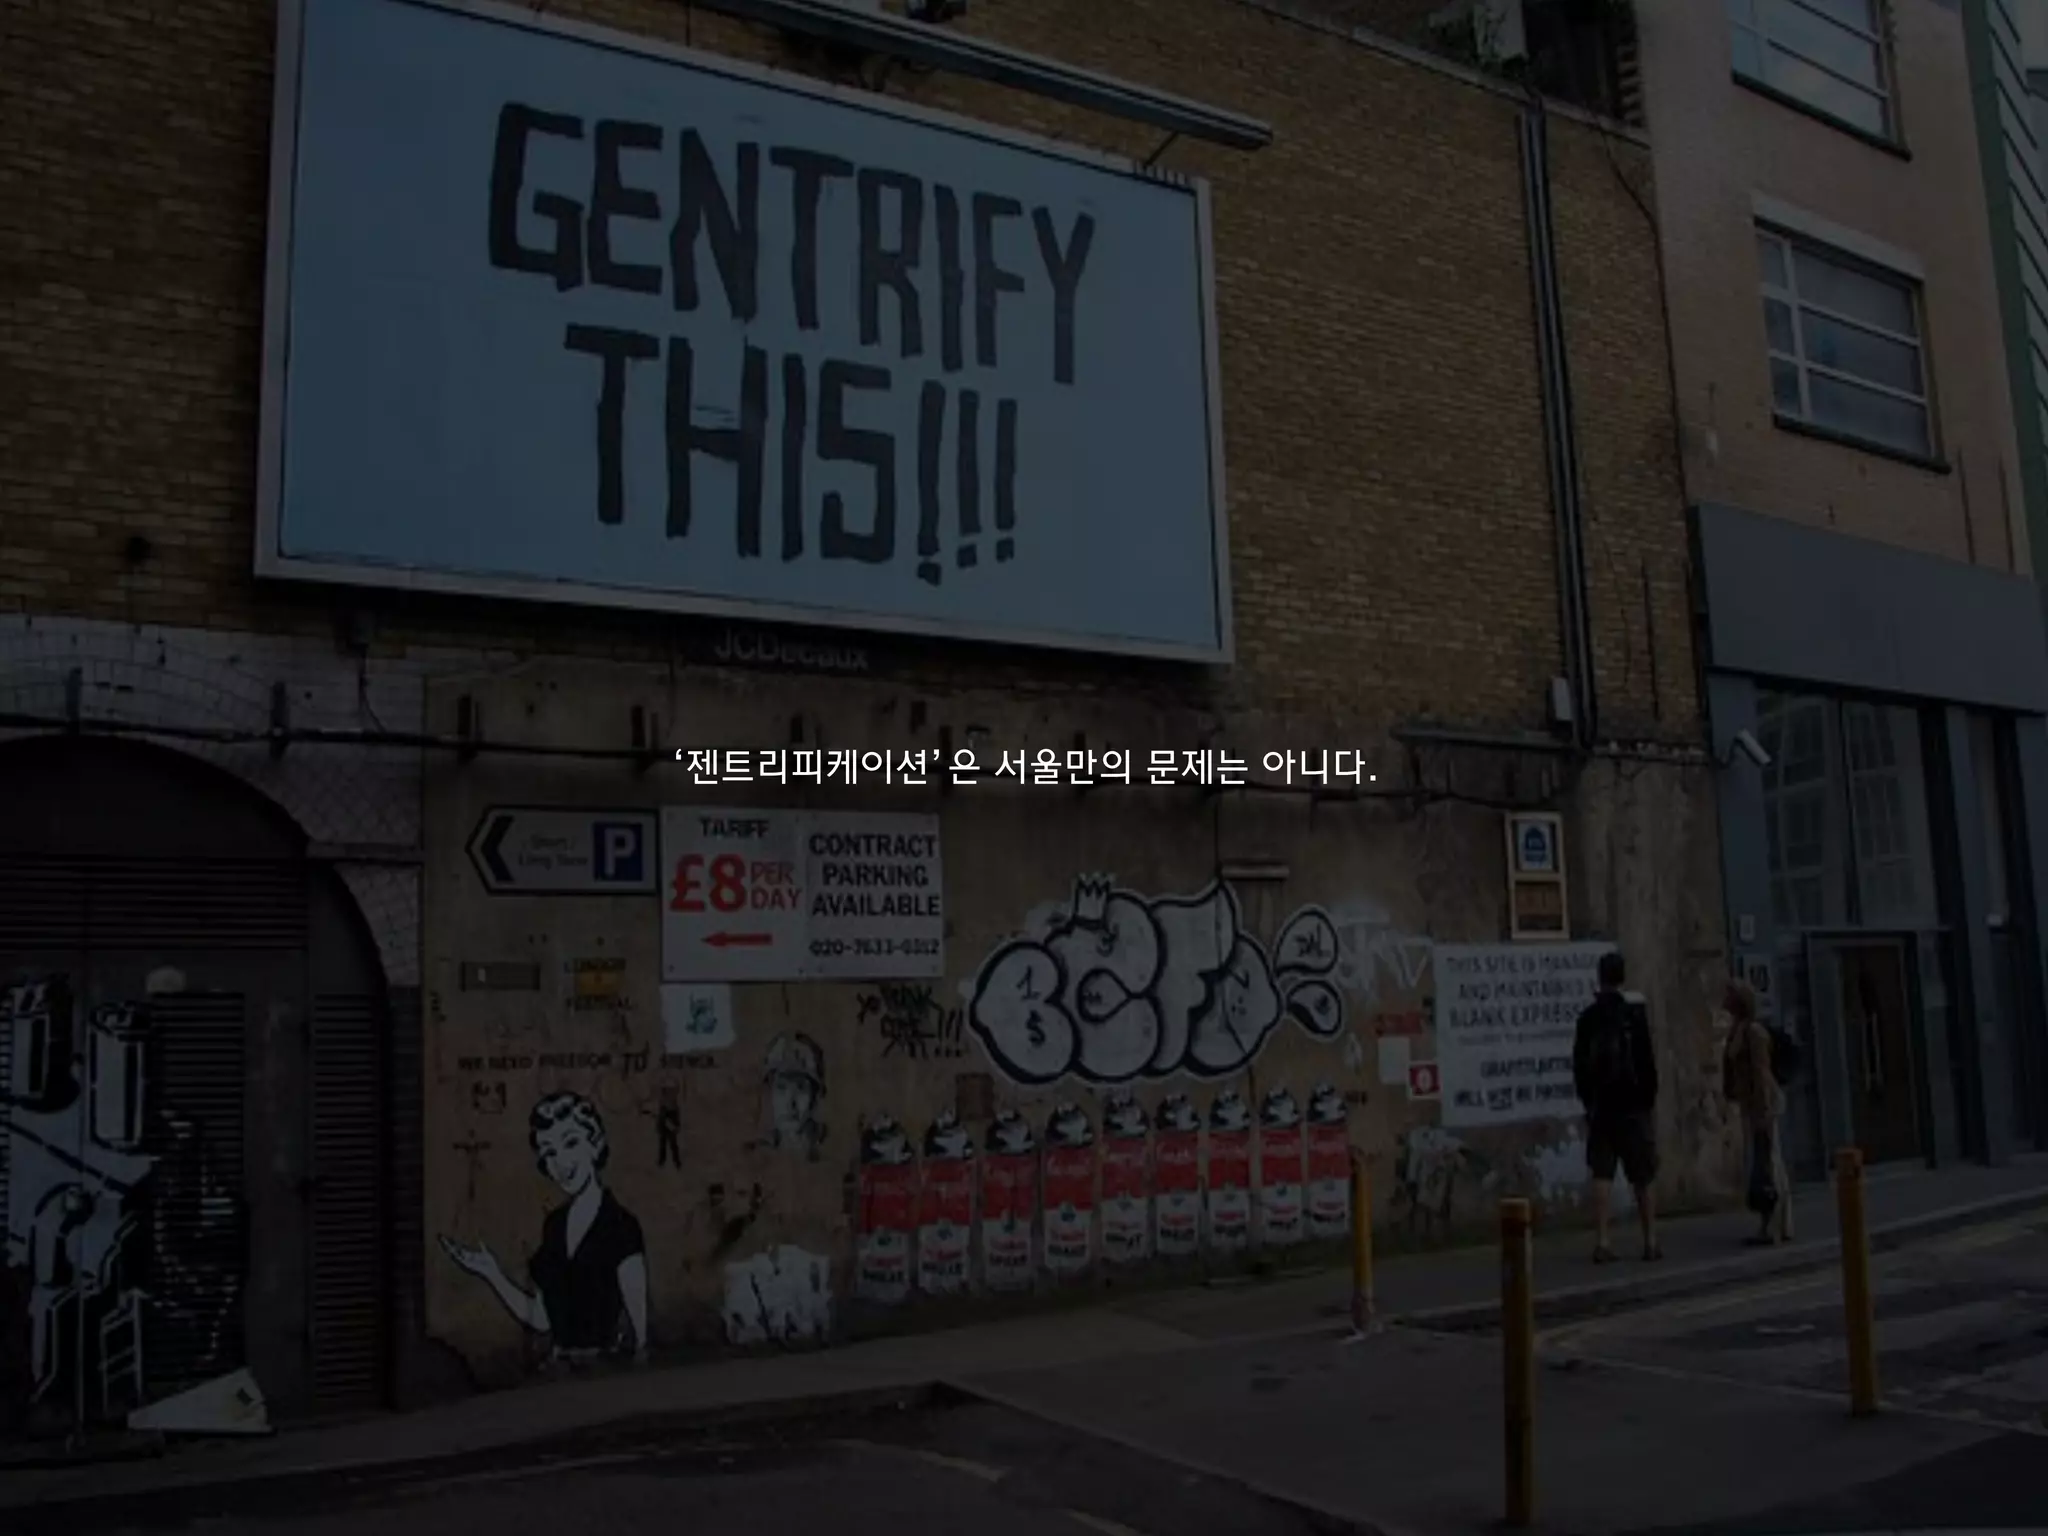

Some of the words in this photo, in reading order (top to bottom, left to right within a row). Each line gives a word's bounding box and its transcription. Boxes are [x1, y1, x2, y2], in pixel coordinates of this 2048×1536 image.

[488, 101, 1095, 385] GENTRIFY
[564, 322, 1018, 585] THIS!!!
[700, 816, 770, 838] TARIFF
[603, 826, 637, 878] P
[809, 833, 937, 858] CONTRACT
[669, 853, 747, 913] £8
[751, 860, 795, 886] PER
[822, 863, 929, 888] PARKING
[751, 887, 802, 910] DAY
[812, 892, 941, 917] AVAILABLE
